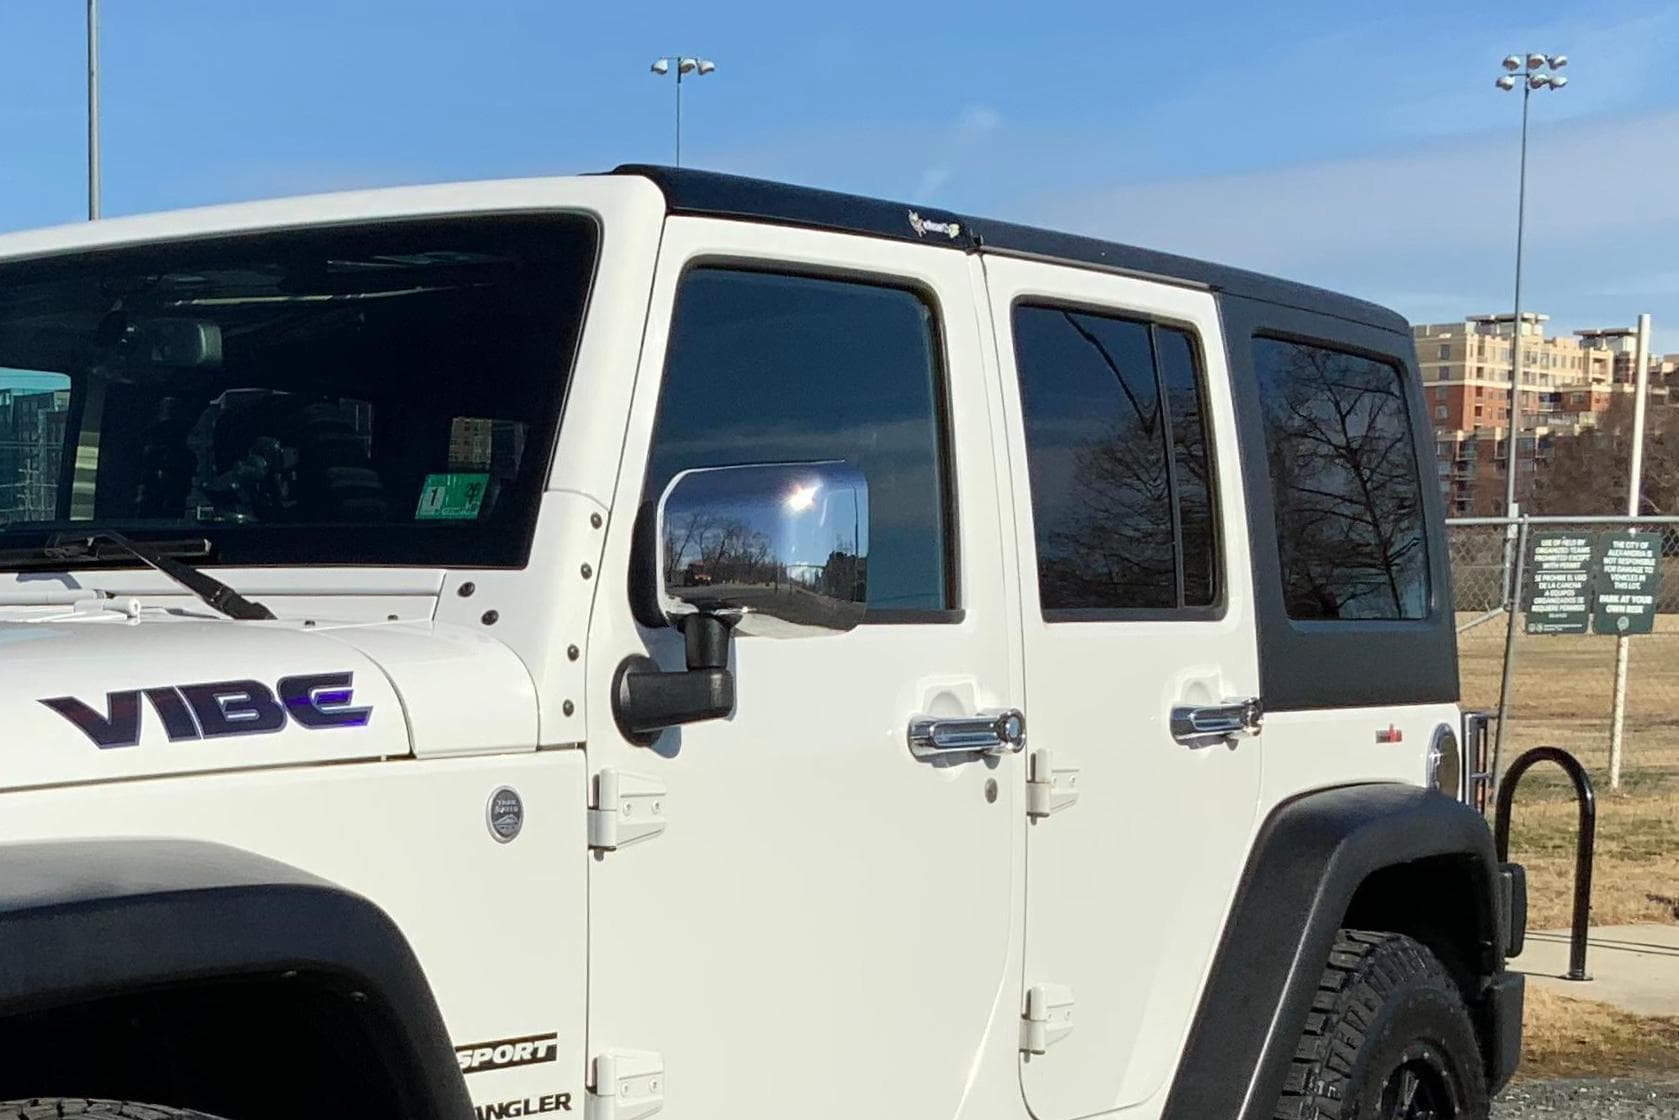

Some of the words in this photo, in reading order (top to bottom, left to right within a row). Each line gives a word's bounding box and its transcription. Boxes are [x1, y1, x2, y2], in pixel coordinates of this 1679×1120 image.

[1553, 539, 1561, 547] OF
[1612, 541, 1625, 549] THE
[1625, 541, 1640, 549] CITY
[1639, 541, 1650, 549] OF
[1607, 549, 1646, 557] ALEXANDRIA
[1603, 557, 1617, 565] NOT
[1617, 557, 1657, 566] RESPONSIBLE
[1603, 565, 1617, 573] FOR
[1616, 566, 1644, 574] DAMAGE
[1643, 566, 1654, 574] TO
[1638, 574, 1647, 582] IN
[1613, 581, 1628, 590] THIS
[1599, 594, 1620, 603] PARK
[1620, 595, 1632, 604] AT
[1631, 595, 1653, 605] YOUR
[1605, 604, 1626, 613] OWN
[1625, 605, 1645, 614] RISK
[34, 670, 375, 750] VIBE
[456, 1039, 558, 1070] SPORT
